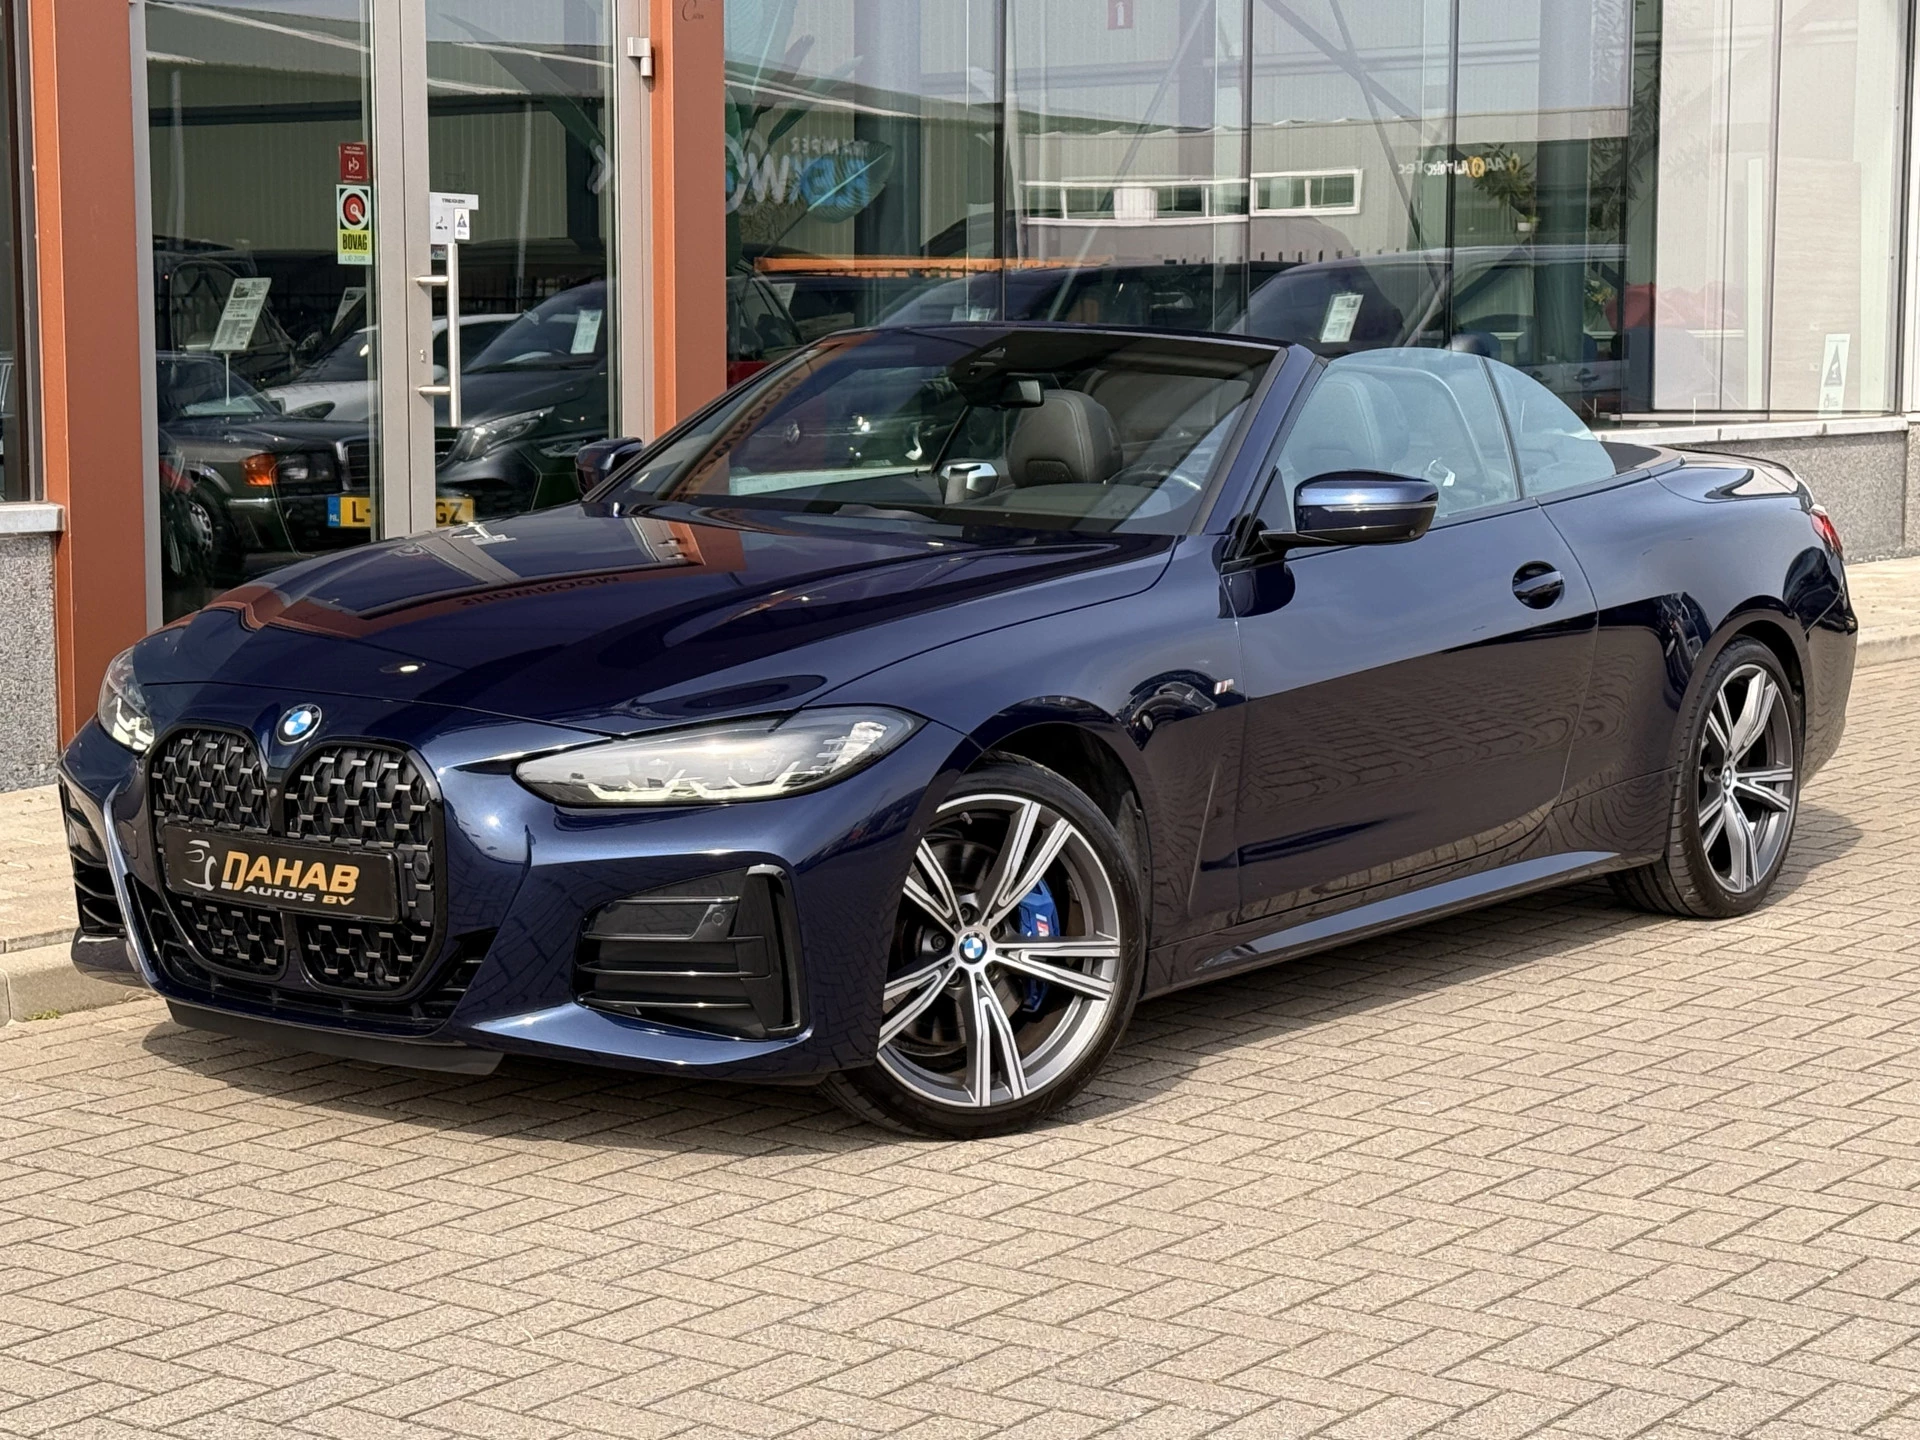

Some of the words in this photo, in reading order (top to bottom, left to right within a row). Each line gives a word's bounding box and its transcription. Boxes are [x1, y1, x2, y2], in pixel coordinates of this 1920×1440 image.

[342, 233, 367, 250] BOVAG
[221, 850, 360, 894] DAHAB
[244, 885, 316, 902] AUTO'S
[322, 895, 355, 905] BV
